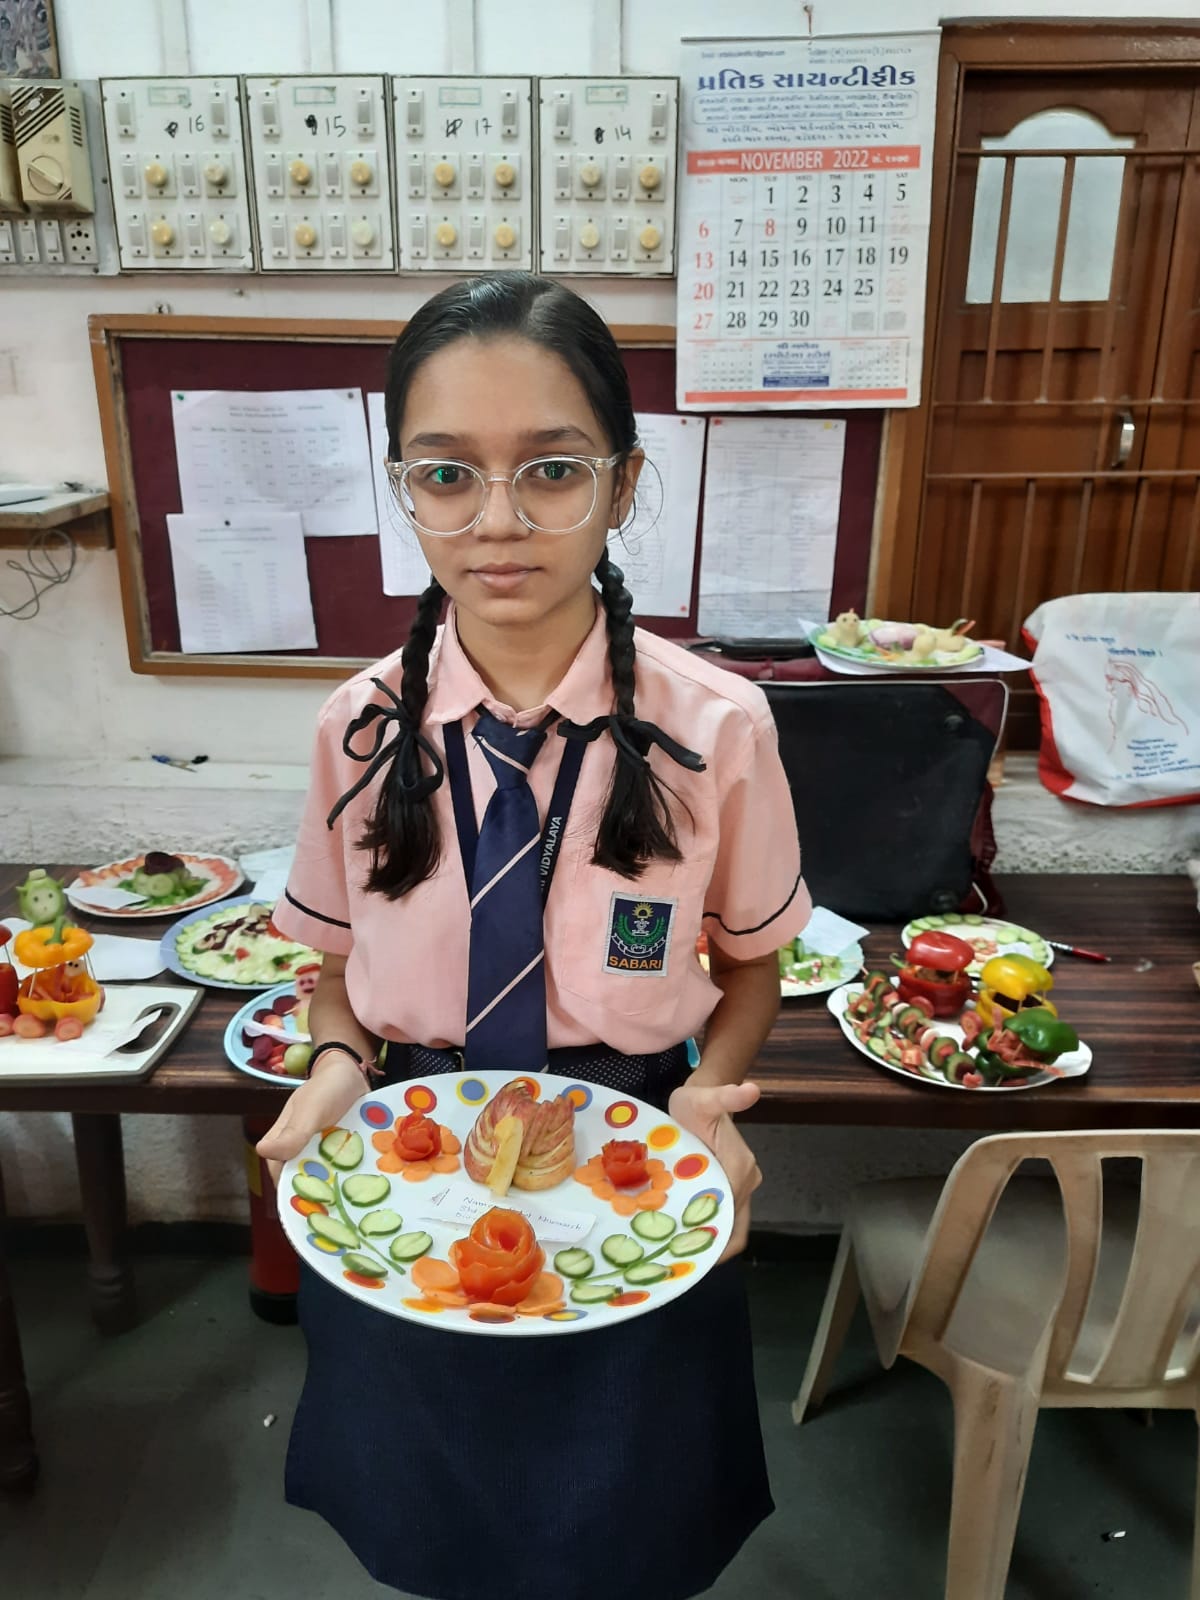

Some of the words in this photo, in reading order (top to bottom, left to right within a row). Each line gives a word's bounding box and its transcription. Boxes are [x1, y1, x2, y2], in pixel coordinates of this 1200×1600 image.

[697, 69, 766, 91] પ્રતિક
[188, 115, 205, 133] 16
[325, 115, 347, 138] 15
[473, 117, 493, 137] 17
[614, 124, 632, 141] 14
[741, 151, 823, 171] NOVEMBER
[833, 150, 869, 168] 2022
[768, 186, 774, 204] 1
[797, 185, 809, 204] 2
[831, 184, 841, 204] 3
[863, 183, 874, 202] 4
[896, 182, 907, 202] 5
[699, 221, 710, 238] 6
[734, 218, 744, 236] 7
[765, 218, 776, 237] 8
[796, 217, 808, 235] 9
[827, 216, 847, 235] 10
[859, 215, 876, 234] 11
[695, 252, 714, 270] 13
[729, 250, 748, 268] 14
[761, 249, 780, 268] 15
[792, 248, 812, 267] 16
[826, 248, 845, 266] 17
[857, 247, 876, 265] 18
[889, 246, 909, 265] 19
[693, 282, 714, 301] 20
[727, 281, 745, 299] 21
[758, 280, 779, 298] 22
[790, 280, 810, 298] 23
[823, 279, 843, 297] 24
[854, 278, 874, 296] 25
[693, 312, 714, 331] 27
[726, 311, 747, 329] 28
[758, 310, 779, 328] 29
[789, 310, 810, 328] 30
[540, 816, 563, 876] VIDYALAYA
[609, 956, 662, 970] SABARI
